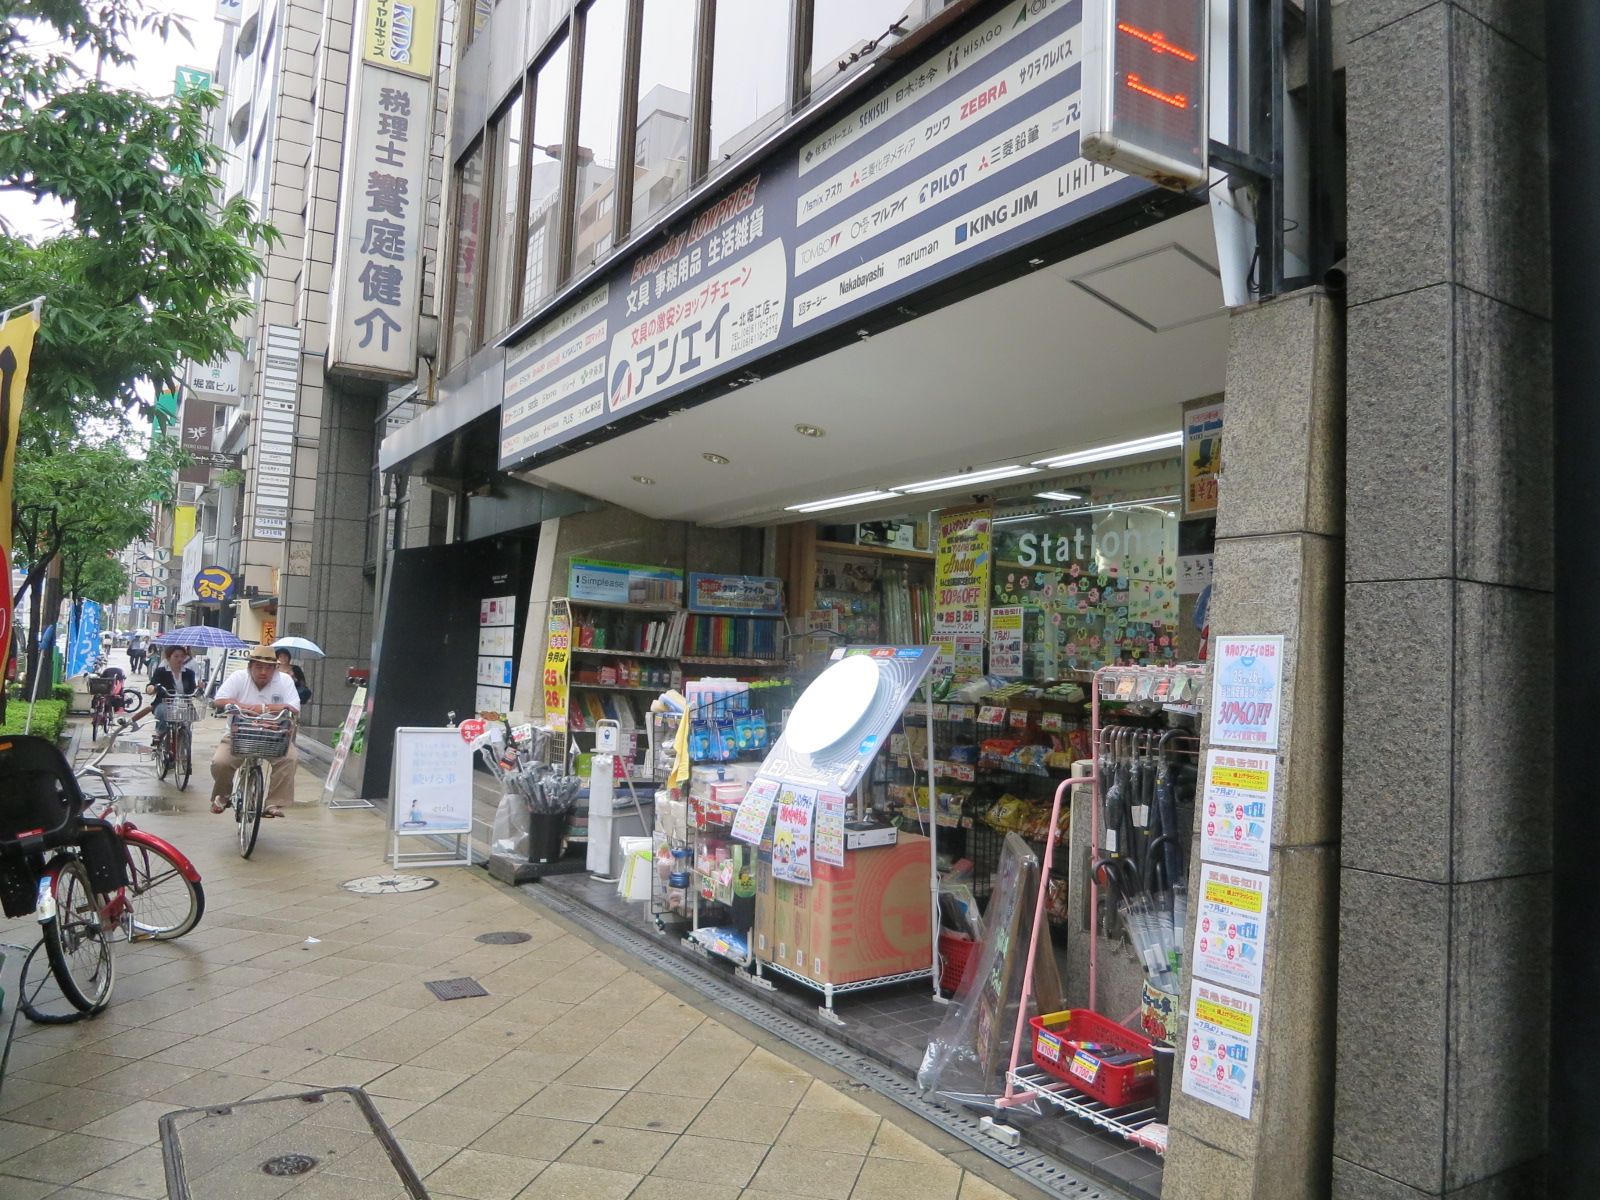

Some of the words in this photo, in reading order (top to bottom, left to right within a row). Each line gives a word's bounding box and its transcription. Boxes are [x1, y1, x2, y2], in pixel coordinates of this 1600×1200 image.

[390, 3, 413, 64] KIDS
[859, 97, 889, 128] SEKISUI
[960, 80, 1008, 120] ZEBRA
[925, 115, 951, 141] クツワ
[990, 124, 1040, 165] 三菱鉛筆
[930, 163, 968, 199] PILOT
[1058, 162, 1096, 198] LIHIT
[871, 196, 908, 226] マルアイ
[969, 205, 1008, 237] KING
[1011, 190, 1038, 218] JIM
[626, 281, 650, 318] 文具
[655, 247, 702, 299] 事務用品
[708, 205, 764, 267] 生活雑貨
[897, 240, 939, 269] maruman
[839, 262, 885, 296] Nakabayashi
[631, 267, 752, 348] 文具の激安ショップチェーン
[635, 302, 730, 396] アンエイ
[193, 378, 237, 393] 堀富ビル
[581, 575, 624, 588] Simplease
[939, 586, 981, 606] 30%OFF
[1218, 701, 1272, 725] 30%OFF
